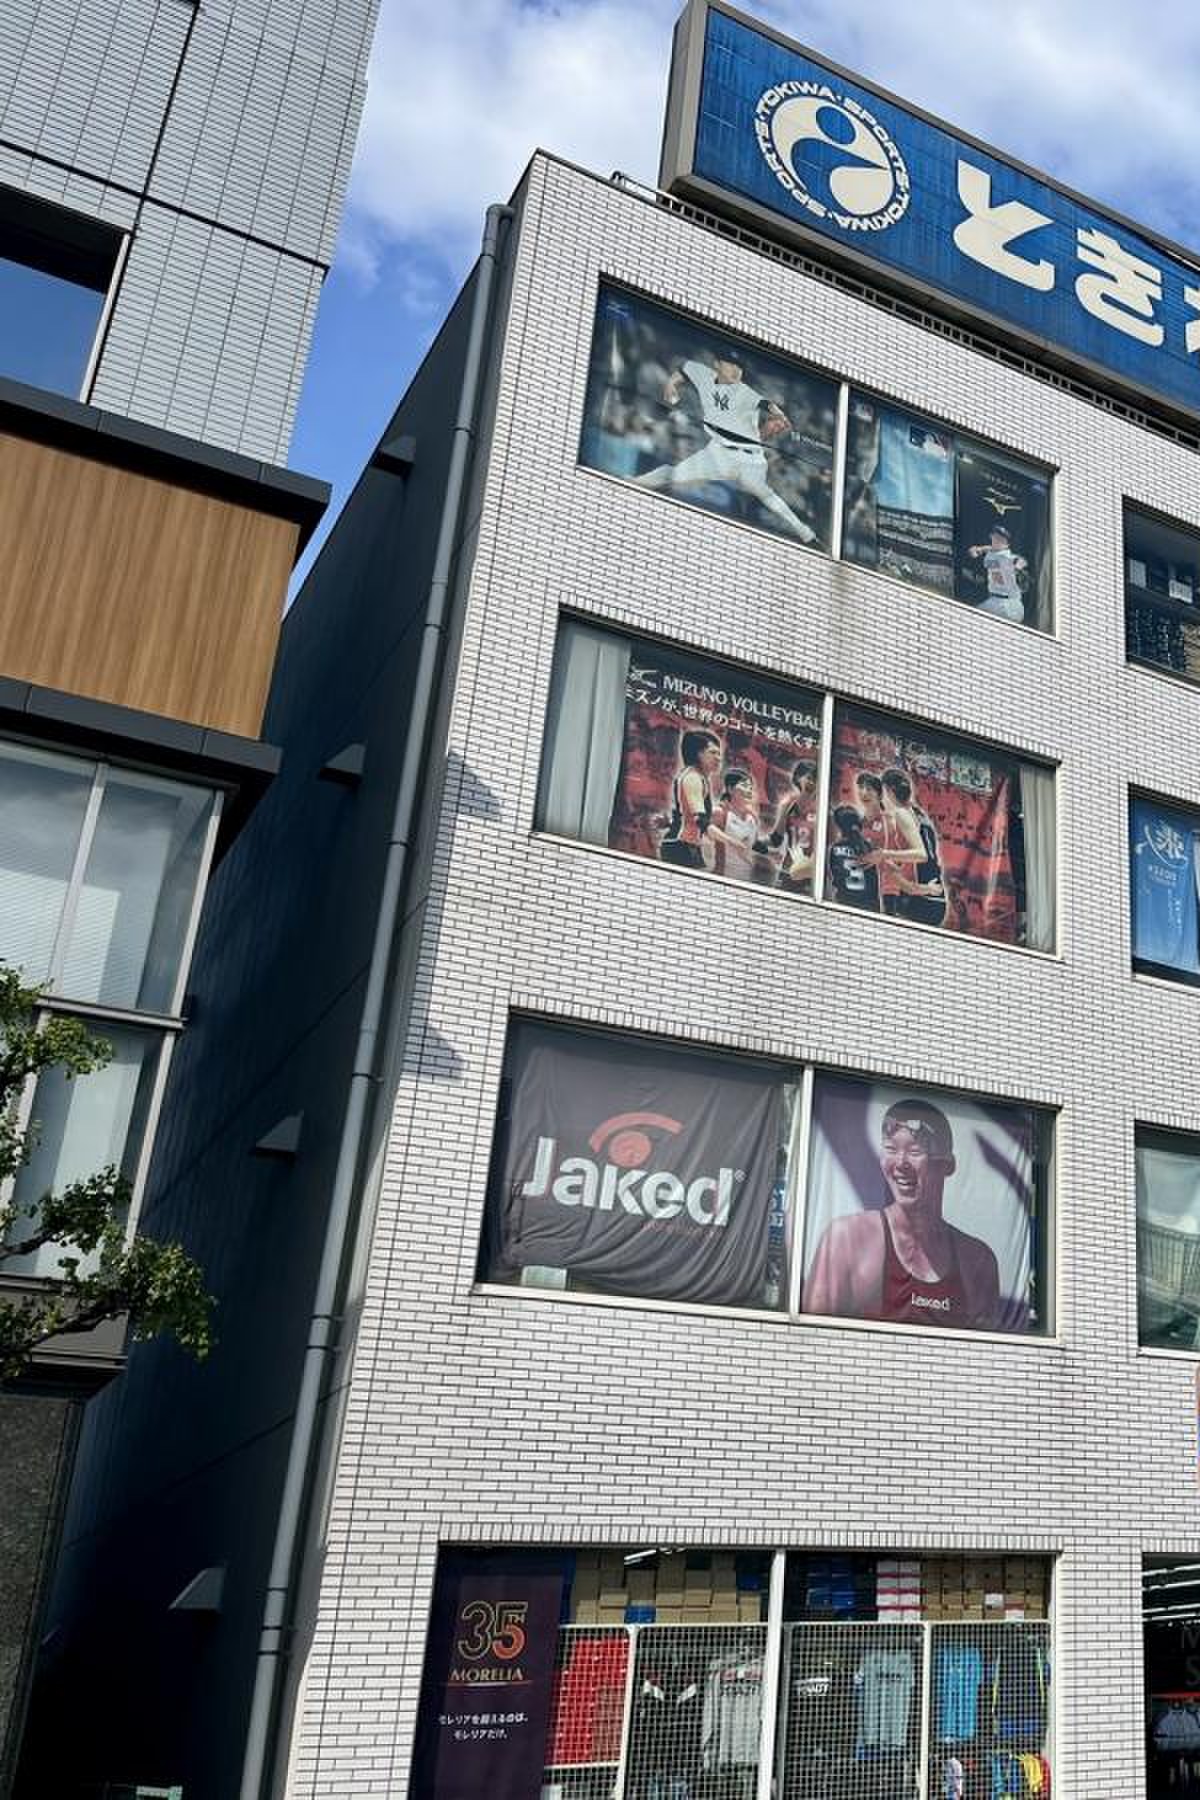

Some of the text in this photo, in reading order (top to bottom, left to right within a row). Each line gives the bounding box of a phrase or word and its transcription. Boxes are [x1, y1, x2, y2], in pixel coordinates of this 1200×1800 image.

[663, 675, 727, 704] MIZUNO
[522, 1136, 733, 1226] Jaked
[458, 1600, 528, 1660] 35
[450, 1667, 524, 1681] MORELIA
